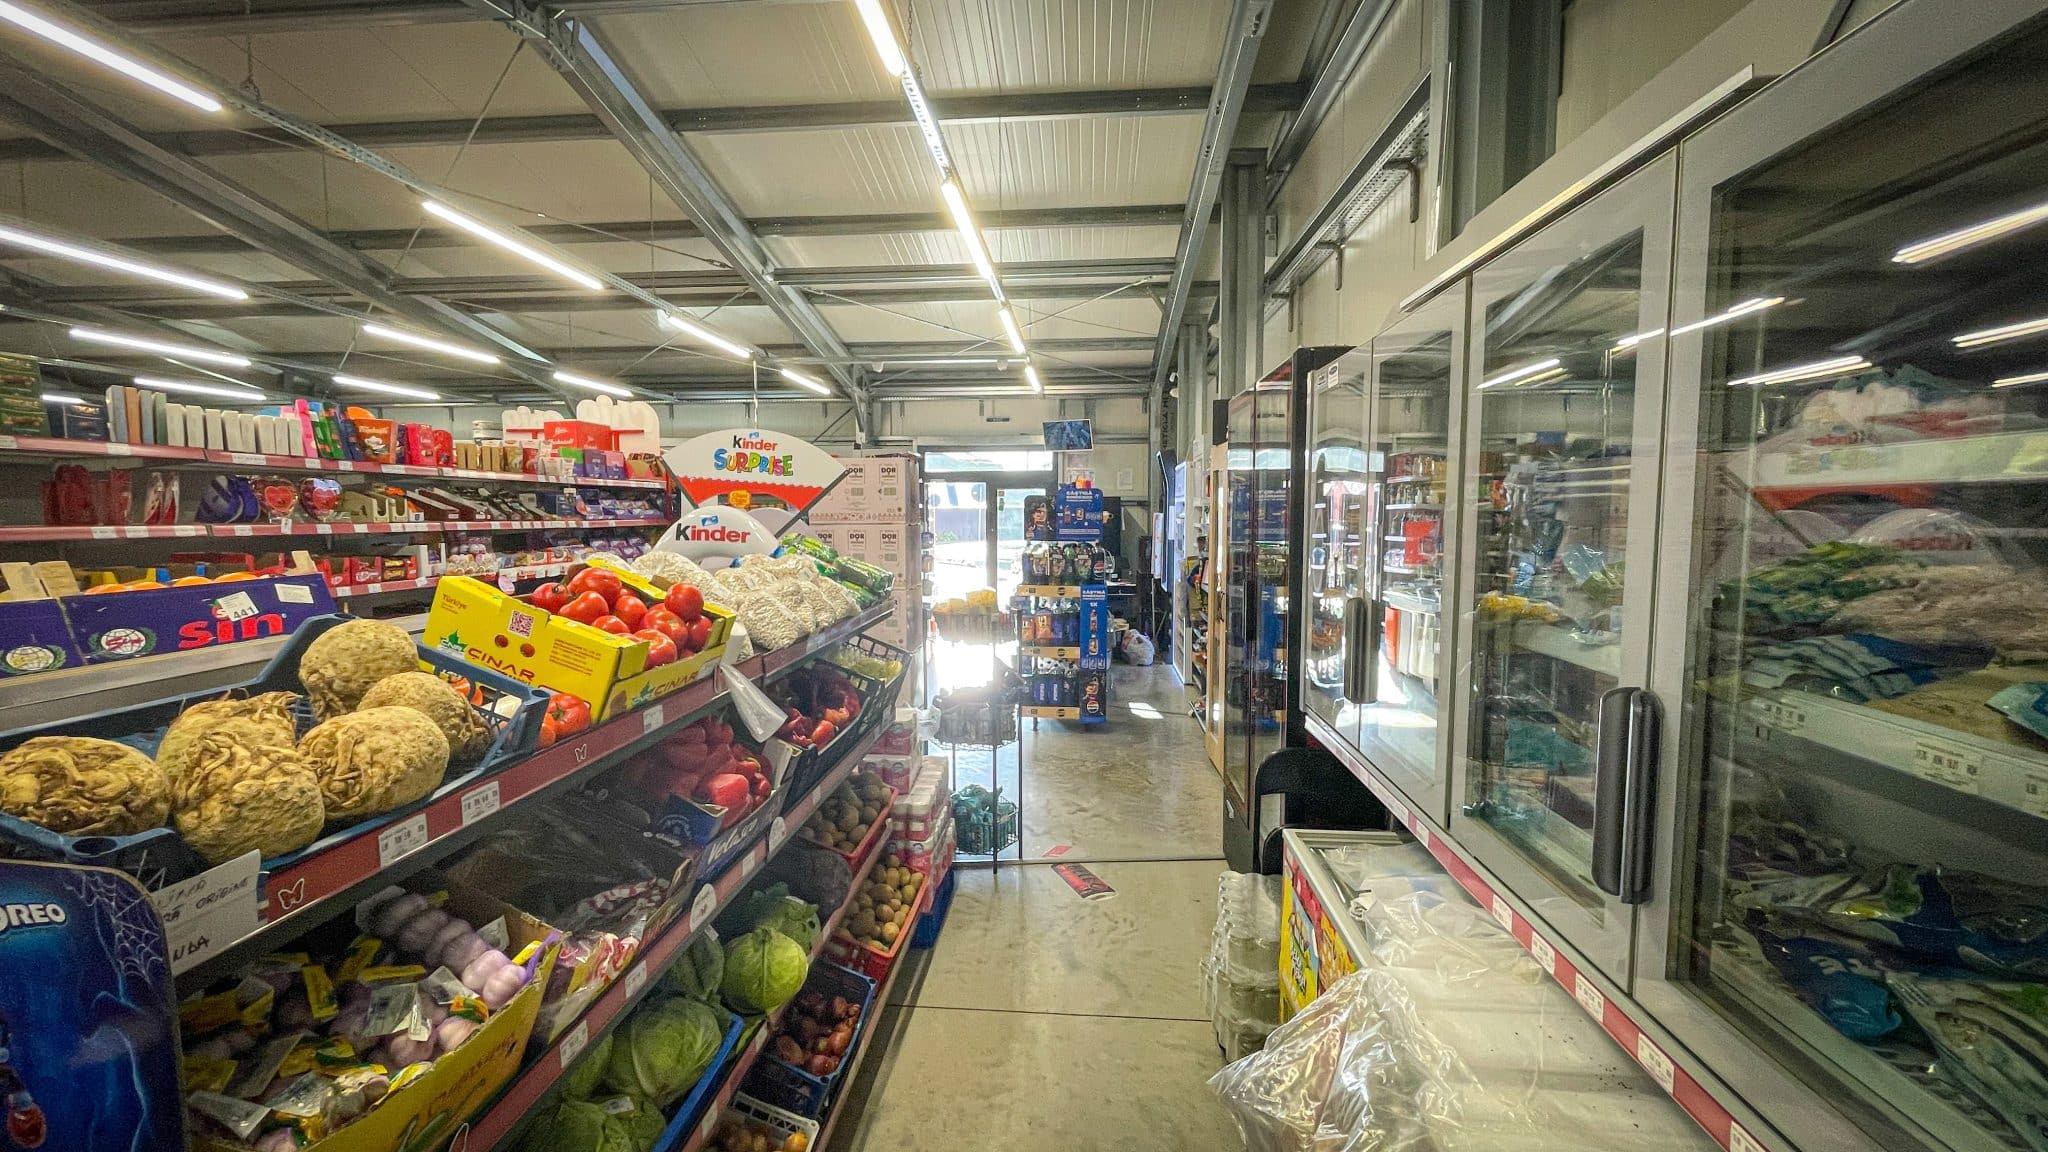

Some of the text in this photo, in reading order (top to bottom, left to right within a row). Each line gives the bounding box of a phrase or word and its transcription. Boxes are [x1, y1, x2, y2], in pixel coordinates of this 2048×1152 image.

[732, 435, 778, 451] Kinder
[714, 448, 794, 477] SURPRISE
[675, 523, 750, 543] Kinder
